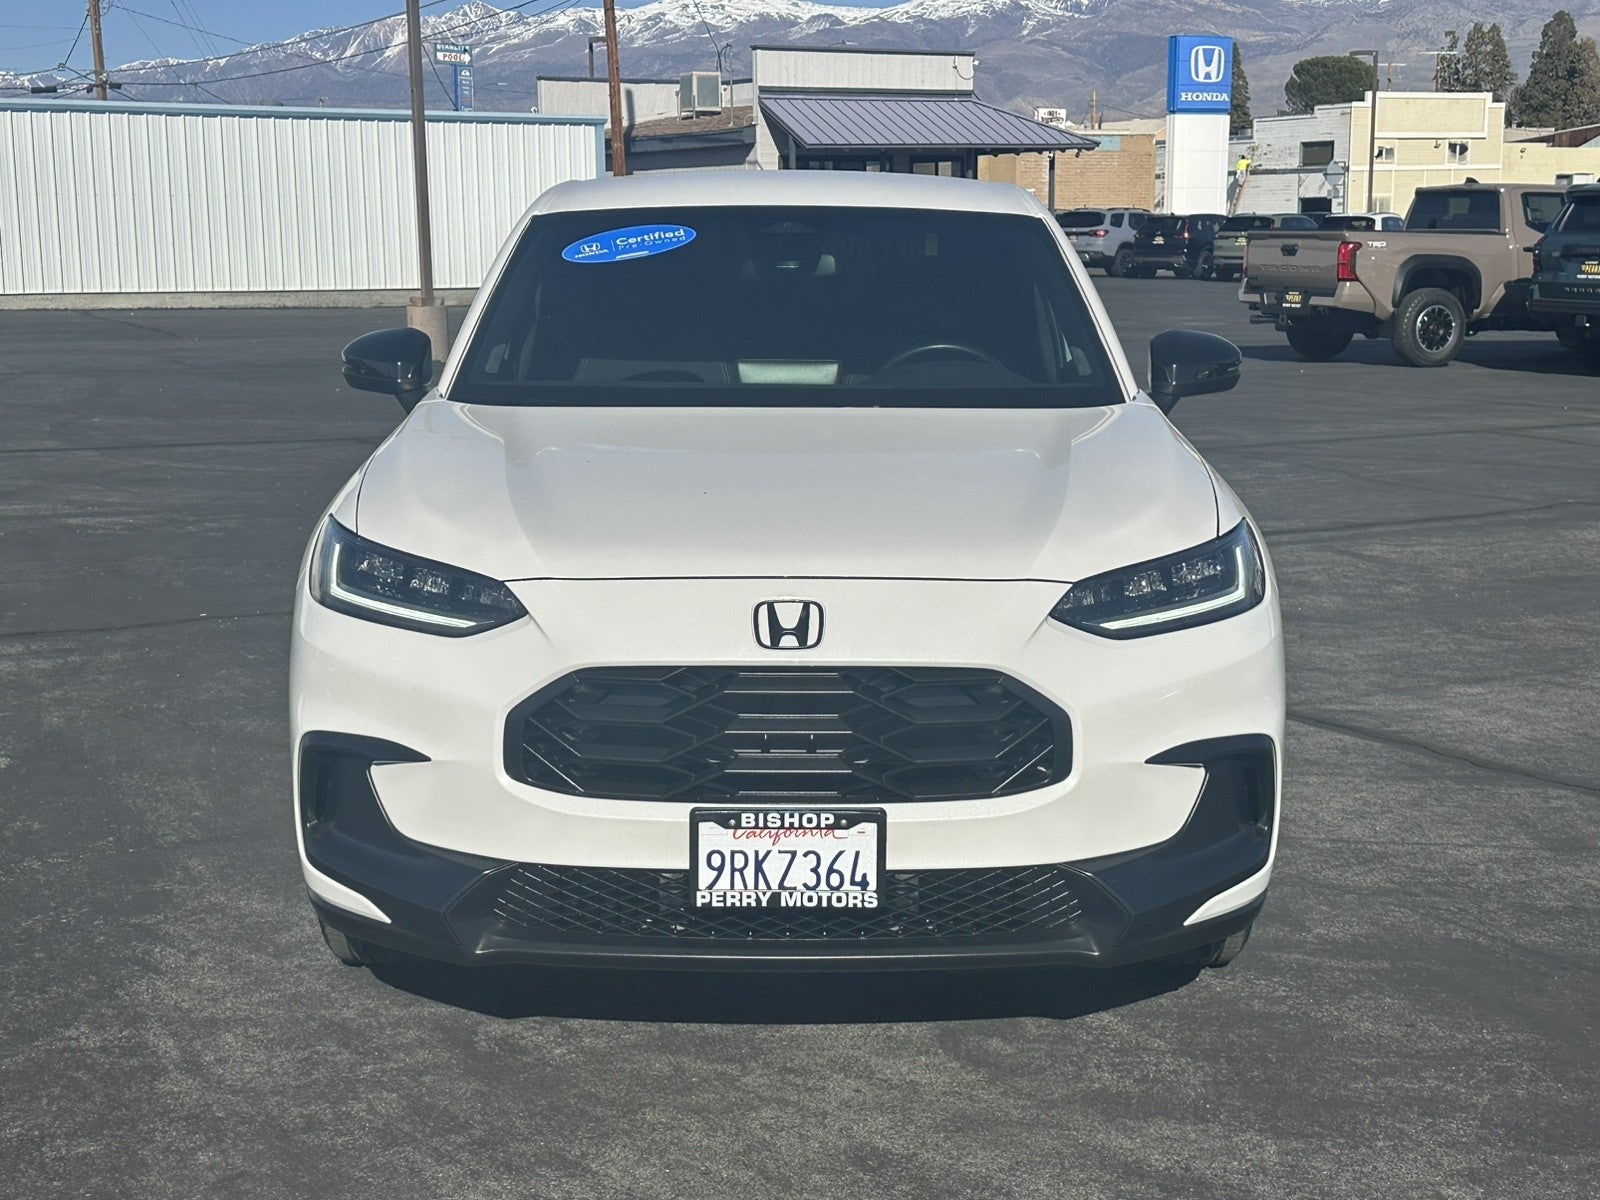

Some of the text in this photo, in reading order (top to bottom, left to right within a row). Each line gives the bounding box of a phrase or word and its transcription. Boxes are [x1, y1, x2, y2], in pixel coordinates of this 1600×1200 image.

[1180, 92, 1230, 102] HONDA
[616, 228, 685, 246] Certified
[618, 235, 686, 250] Pre-Owned
[1260, 264, 1321, 273] TACOMA
[741, 812, 835, 828] BISHOP
[706, 849, 870, 891] 9RKZ364
[696, 891, 878, 908] PERRY MOTORS
